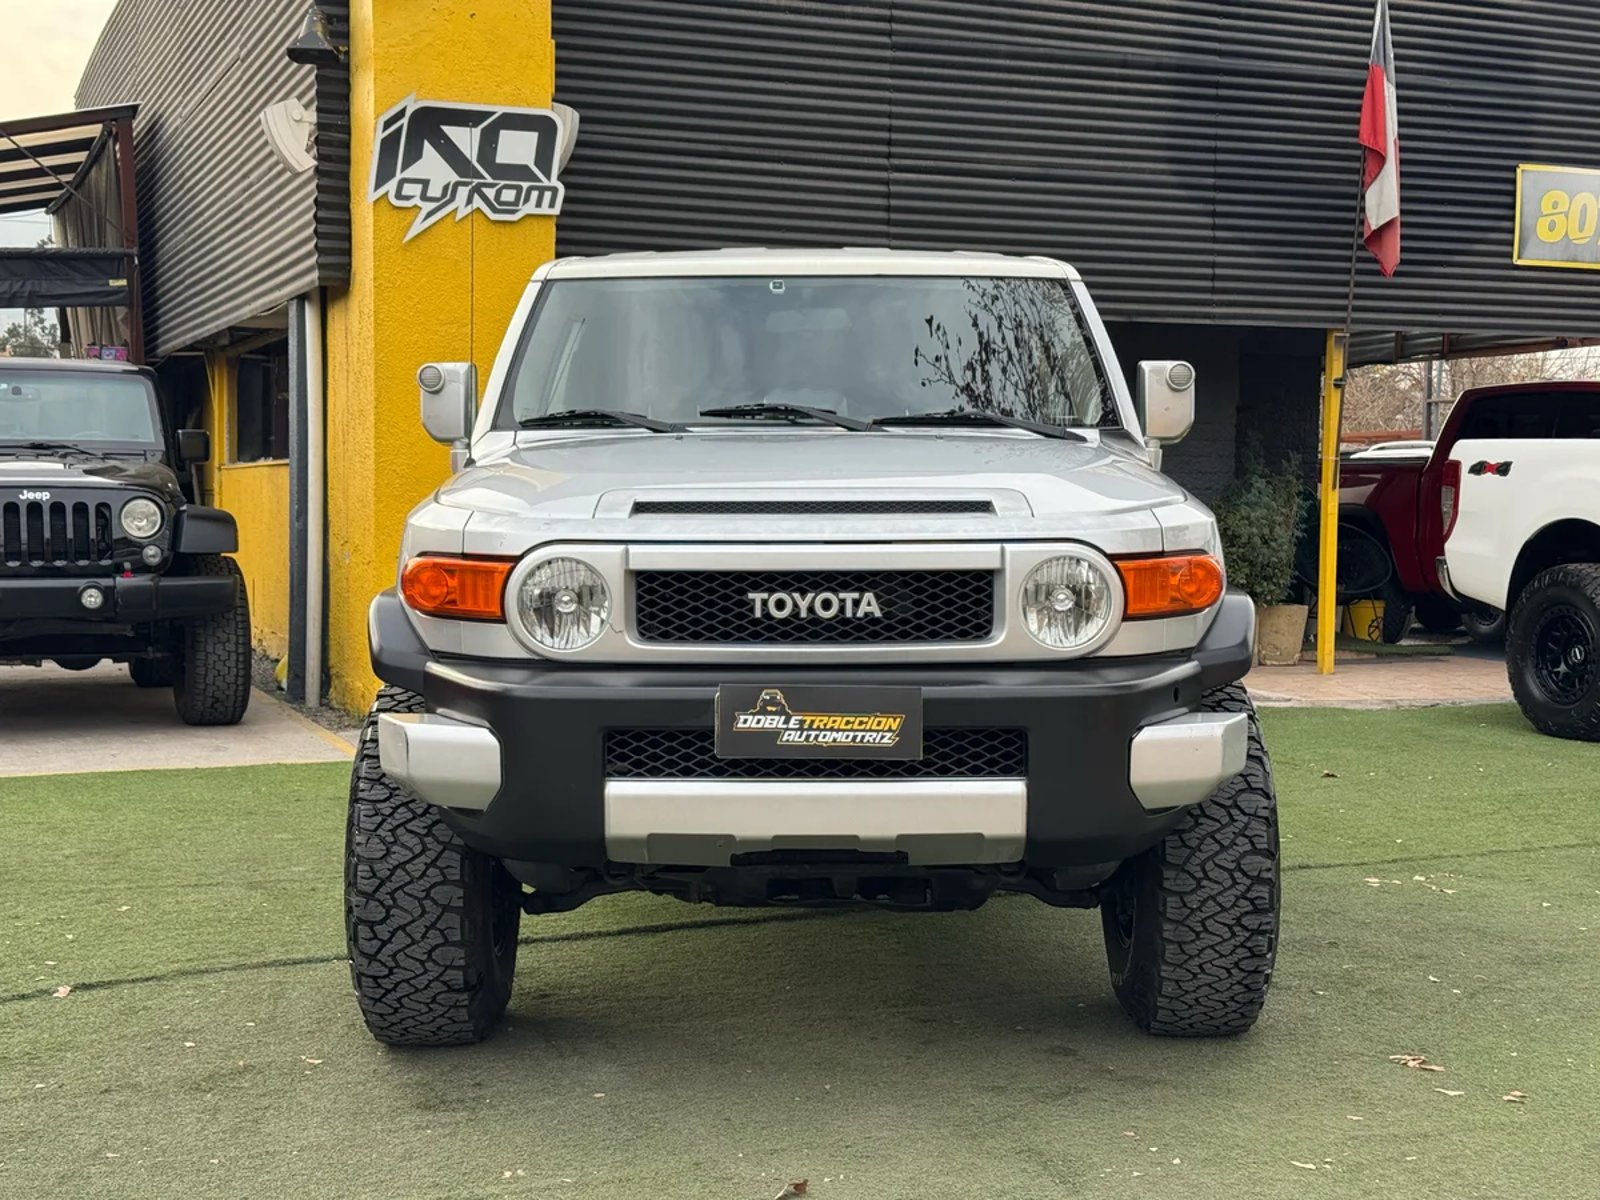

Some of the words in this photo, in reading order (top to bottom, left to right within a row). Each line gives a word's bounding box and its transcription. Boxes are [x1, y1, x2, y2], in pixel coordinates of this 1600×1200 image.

[1536, 190, 1600, 245] 80
[18, 489, 51, 502] Jeep
[748, 591, 882, 619] TOYOTA
[781, 730, 894, 744] AUTOMOTRIZ
